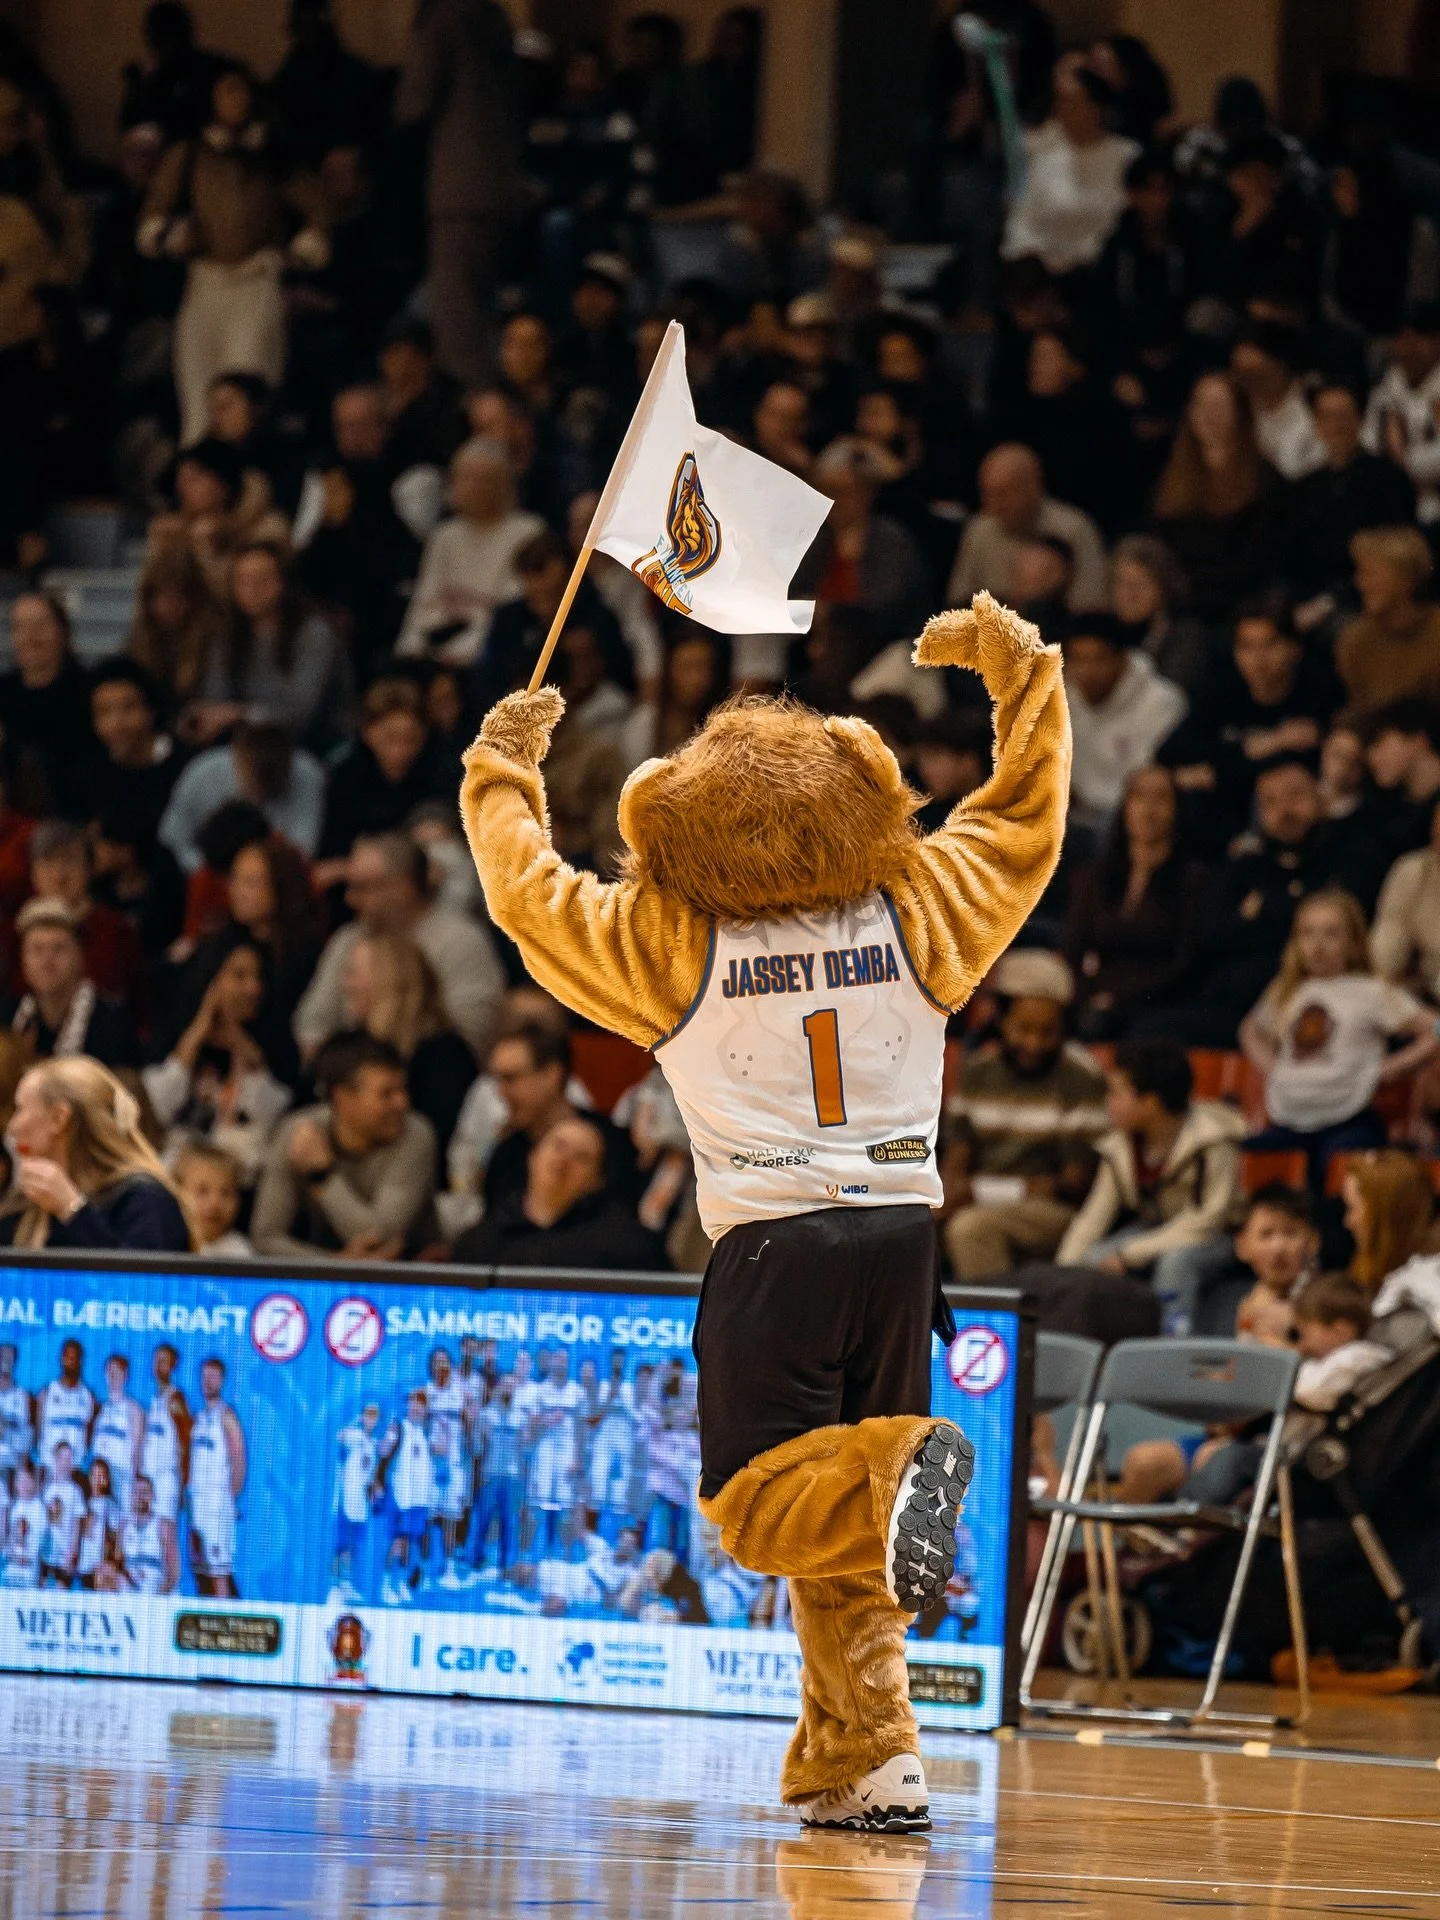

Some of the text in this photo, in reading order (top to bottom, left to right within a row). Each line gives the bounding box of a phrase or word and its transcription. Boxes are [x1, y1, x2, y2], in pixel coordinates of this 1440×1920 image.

[721, 942, 900, 999] JASSEY DEMBA
[802, 1008, 847, 1128] 1
[753, 1155, 810, 1168] EXPRESS
[887, 1150, 927, 1160] BUNKERS
[841, 1184, 869, 1194] WIBO
[53, 1298, 247, 1336] BÆREKRAFT
[385, 1305, 527, 1341] SAMMEN
[537, 1313, 604, 1345] FOR
[411, 1633, 529, 1674] I care.
[901, 1774, 920, 1785] NIKE
